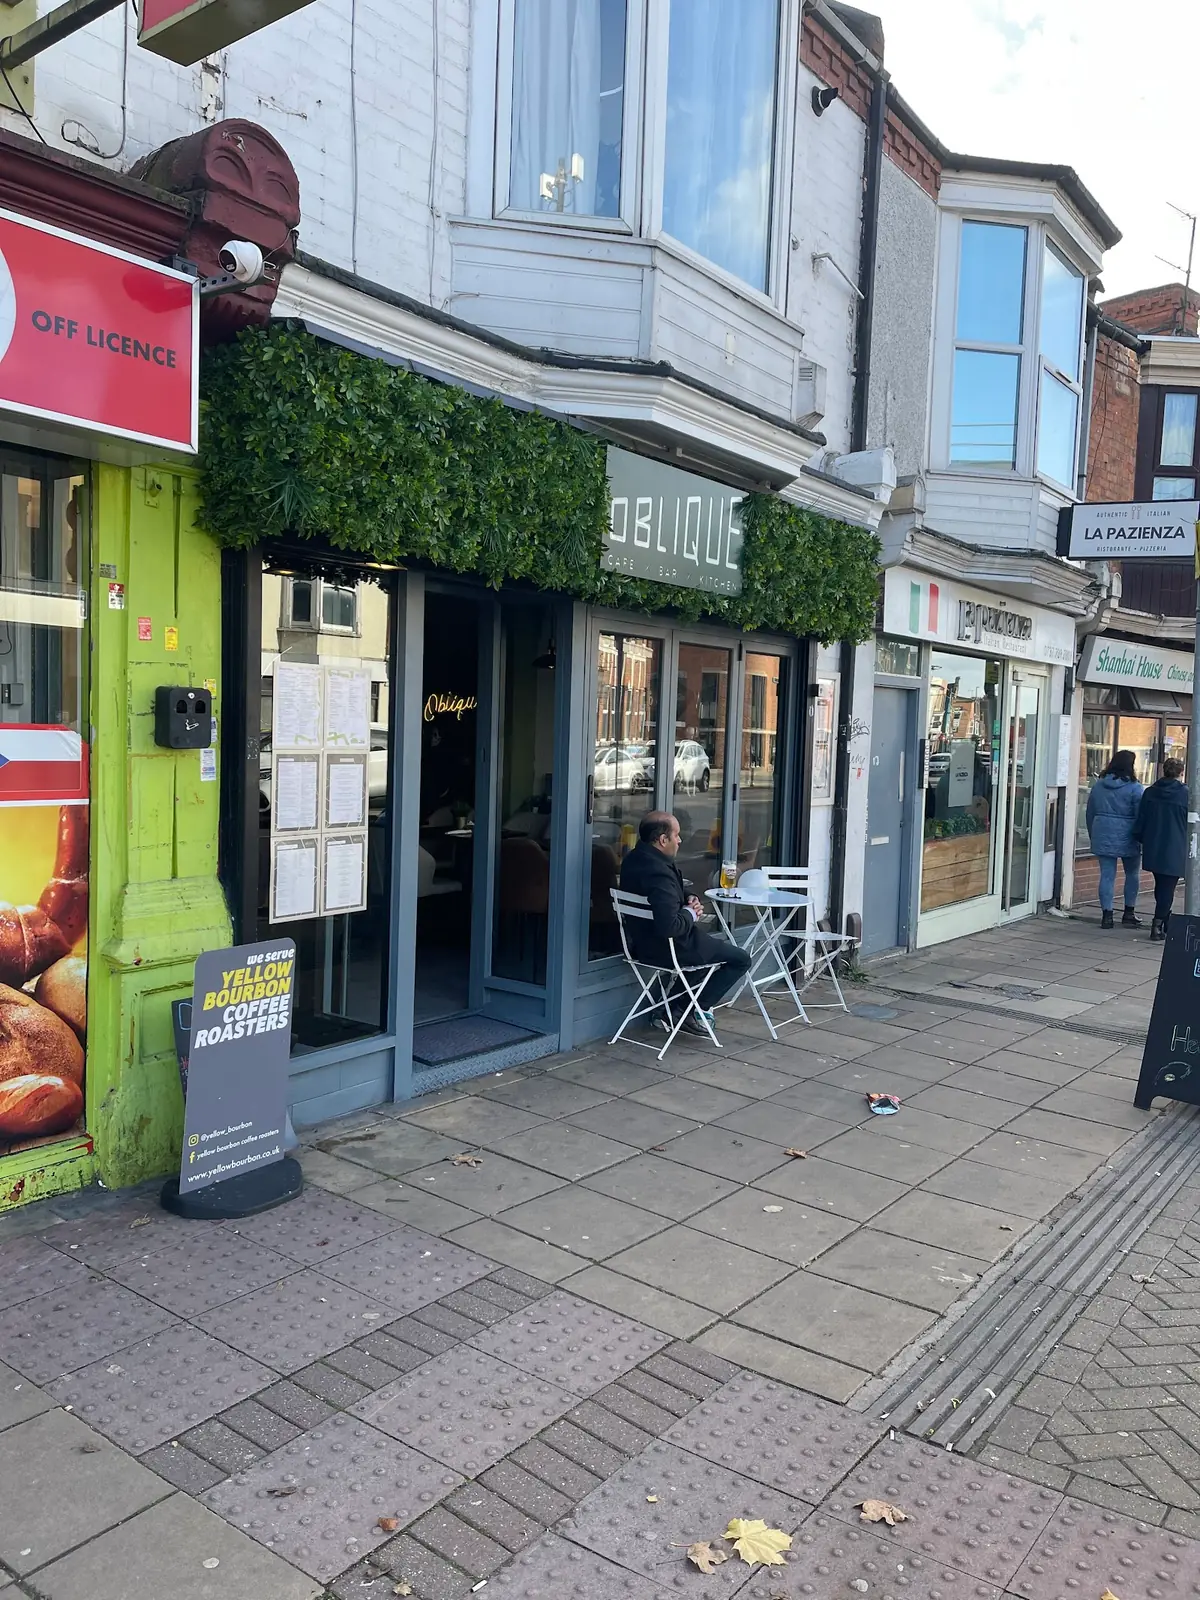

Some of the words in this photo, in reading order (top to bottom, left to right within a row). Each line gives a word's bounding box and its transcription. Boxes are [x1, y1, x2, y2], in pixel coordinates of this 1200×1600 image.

[32, 310, 78, 340] OFF
[86, 325, 177, 369] LICENCE
[609, 496, 743, 570] OBLIQUE
[1084, 527, 1103, 540] LA
[1106, 526, 1186, 540] PAZIENZA
[607, 554, 634, 571] CAFE
[659, 565, 678, 578] BAR
[699, 575, 737, 592] KITCHEN
[1095, 646, 1138, 676] Shanhai
[1135, 655, 1164, 680] House
[222, 959, 294, 989] YELLOW
[246, 954, 264, 966] we
[264, 948, 295, 963] serve
[202, 977, 292, 1011] BOURBON
[222, 993, 291, 1024] COFFEE
[194, 1010, 290, 1049] ROASTERS
[196, 1148, 216, 1161] yellow
[216, 1140, 241, 1153] bourbon
[240, 1134, 258, 1145] coffee
[258, 1128, 280, 1140] roasters
[200, 1121, 253, 1142] @yellow_bourbon
[187, 1145, 281, 1183] www.yellowbourbon.co.uk
